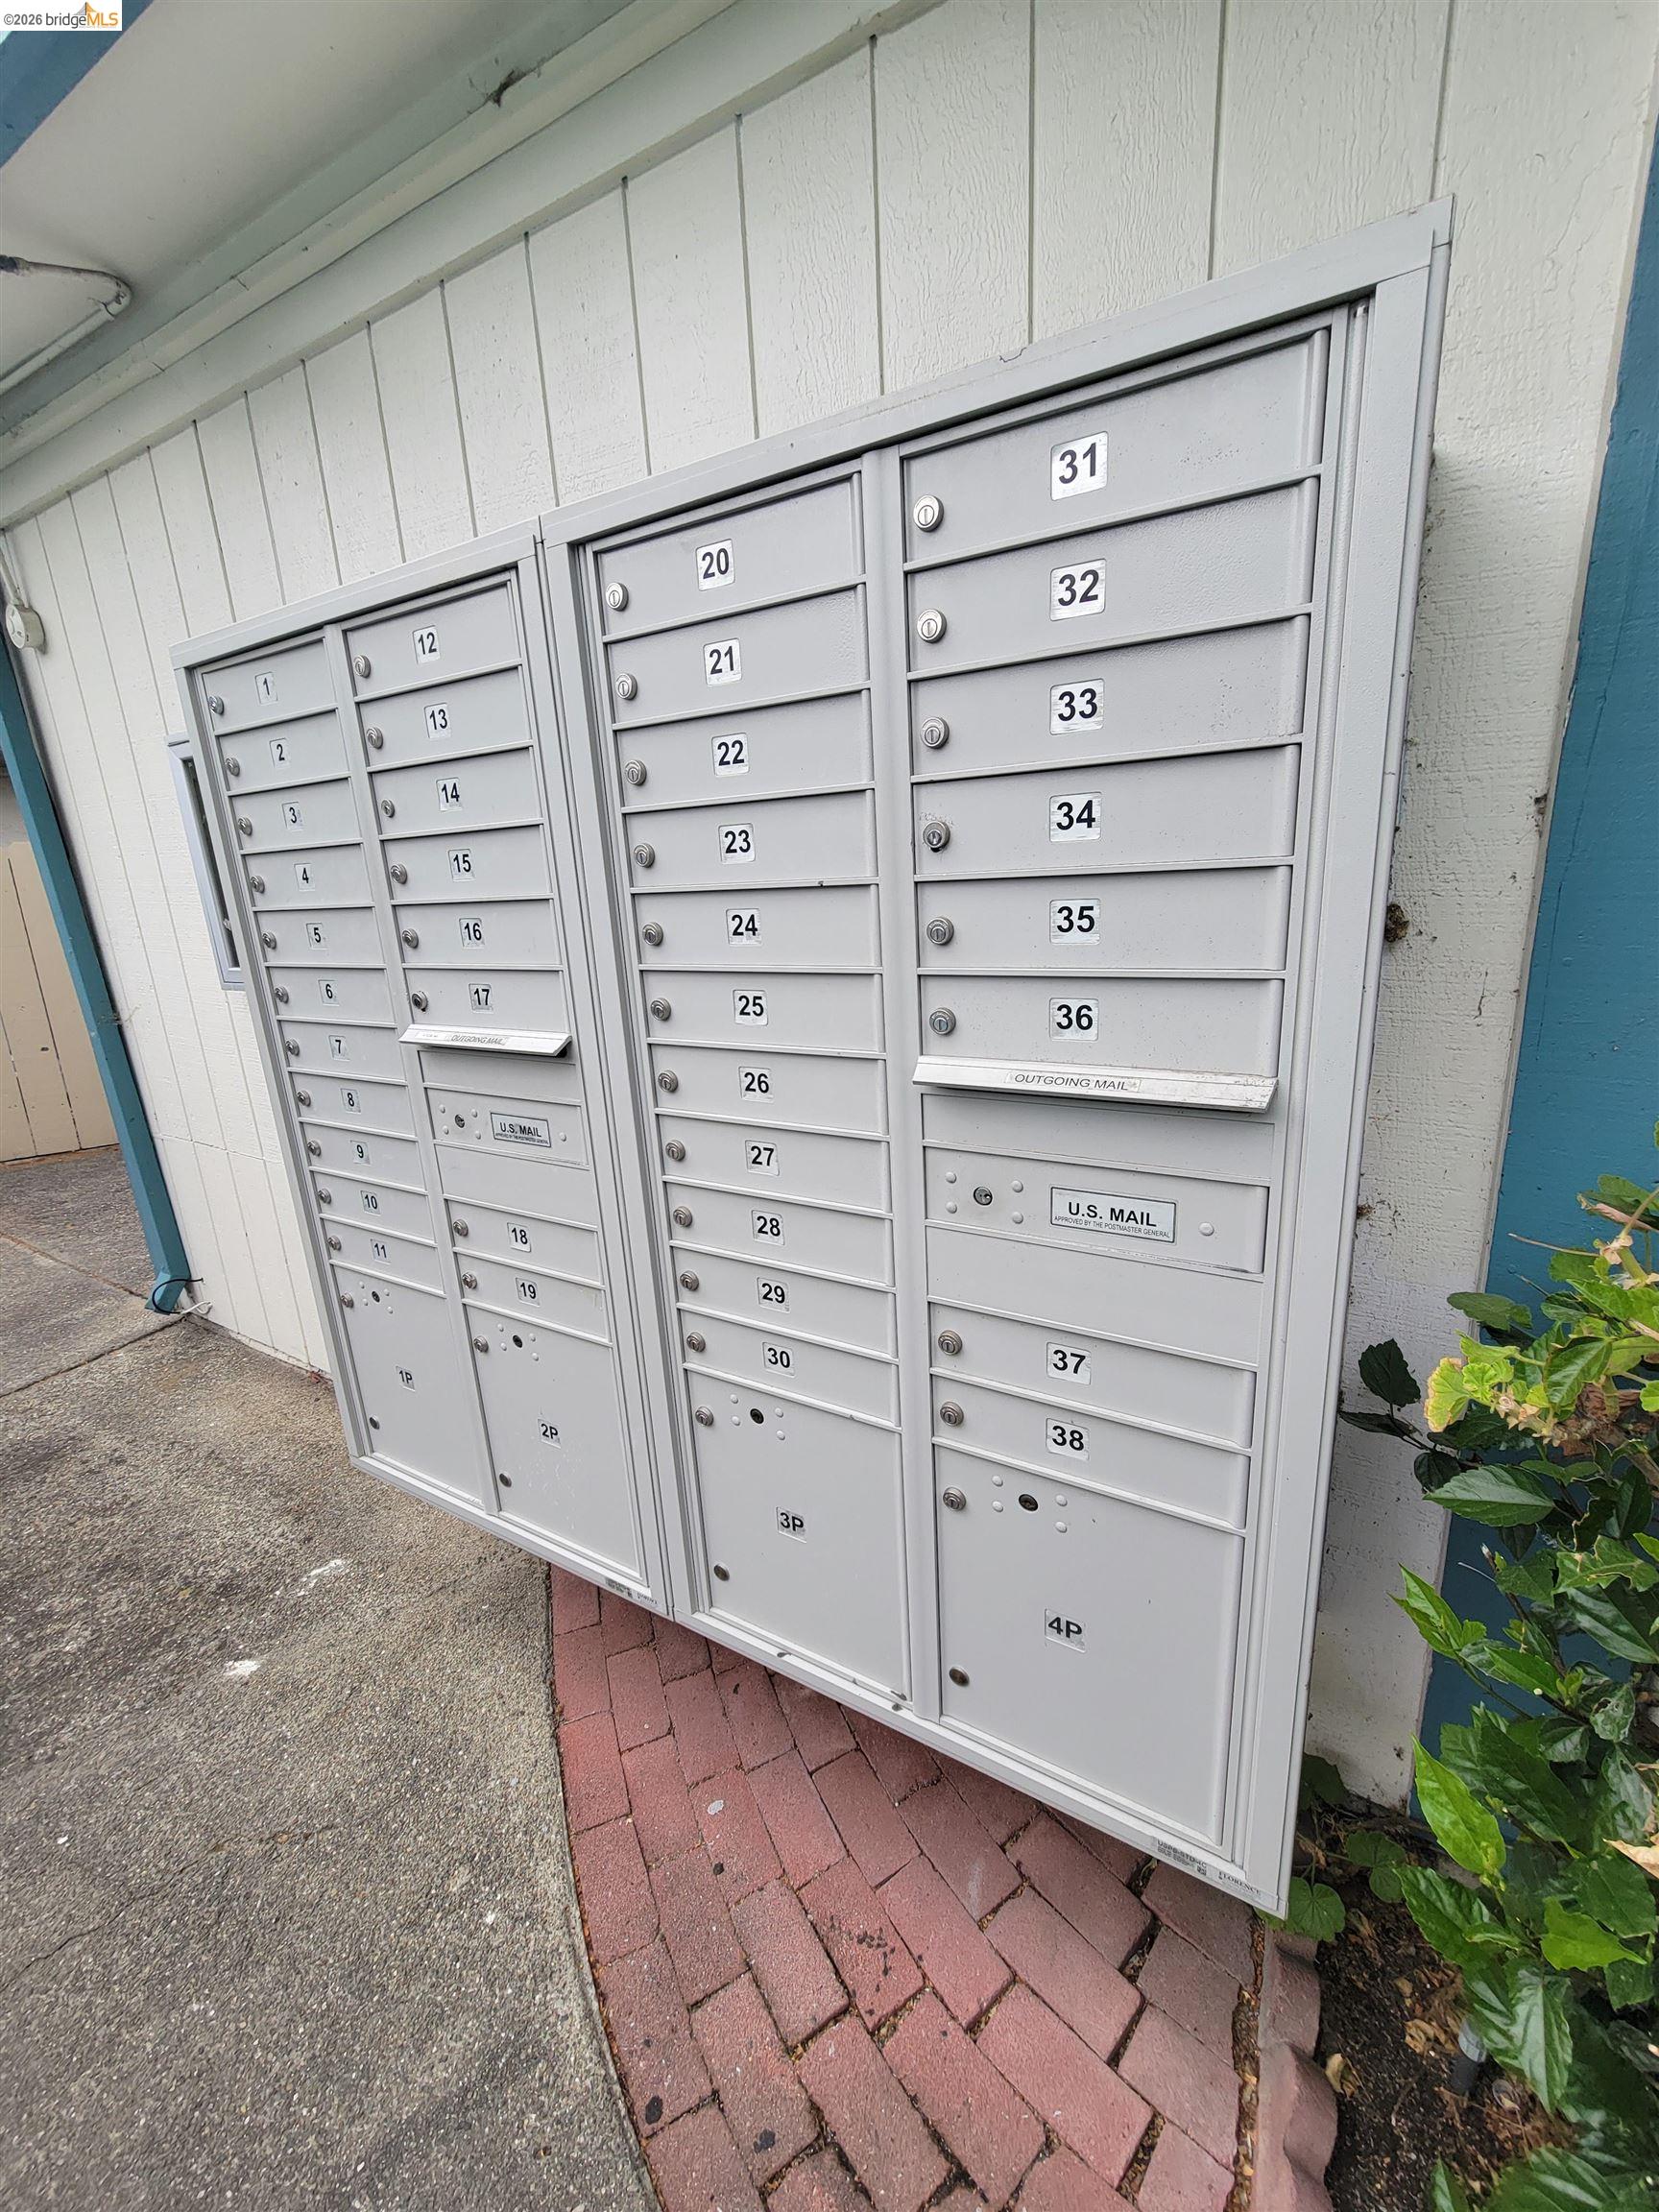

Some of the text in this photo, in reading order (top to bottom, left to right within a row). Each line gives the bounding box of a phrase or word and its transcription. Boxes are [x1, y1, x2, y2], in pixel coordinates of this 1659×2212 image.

[1059, 443, 1095, 484] 31
[702, 548, 729, 579] 20
[1058, 569, 1099, 607] 32
[418, 632, 438, 655] 12
[709, 646, 733, 674] 21
[262, 677, 271, 696] 1
[1058, 688, 1097, 721] 33
[429, 709, 448, 731] 13
[276, 743, 285, 761] 2
[718, 740, 744, 766] 22
[441, 782, 460, 804] 14
[289, 806, 298, 824] 3
[1057, 800, 1095, 830] 34
[725, 830, 750, 854] 23
[453, 854, 471, 873] 15
[301, 867, 310, 884] 4
[732, 915, 757, 936] 24
[1057, 906, 1094, 932] 35
[313, 926, 322, 944] 5
[464, 922, 482, 941] 16
[325, 983, 333, 999] 6
[473, 987, 490, 1006] 17
[739, 996, 763, 1016] 25
[1057, 1004, 1093, 1030] 36
[334, 1039, 342, 1054] 7
[451, 1034, 506, 1046] OUTGOING MAIL
[745, 1072, 769, 1094] 26
[1015, 1073, 1129, 1091] OUTGOING MAIL
[347, 1092, 355, 1107] 8
[500, 1121, 541, 1137] U.S. MAIL
[356, 1143, 365, 1159] 9
[751, 1146, 774, 1166] 27
[364, 1193, 378, 1210] 10
[1069, 1202, 1157, 1227] U.S. MAIL
[511, 1227, 528, 1245] 18
[757, 1216, 781, 1237] 28
[1054, 1215, 1083, 1226] APPROVED
[1104, 1222, 1142, 1234] POSTMASTER
[1142, 1228, 1170, 1238] GENERAL
[373, 1242, 387, 1259] 11
[519, 1282, 537, 1300] 19
[762, 1283, 784, 1303] 29
[768, 1348, 790, 1368] 30
[1053, 1350, 1085, 1374] 37
[398, 1369, 413, 1384] 1P
[541, 1423, 559, 1440] 2P
[1052, 1426, 1084, 1451] 38
[781, 1513, 804, 1531] 3P
[1048, 1617, 1082, 1638] 4P
